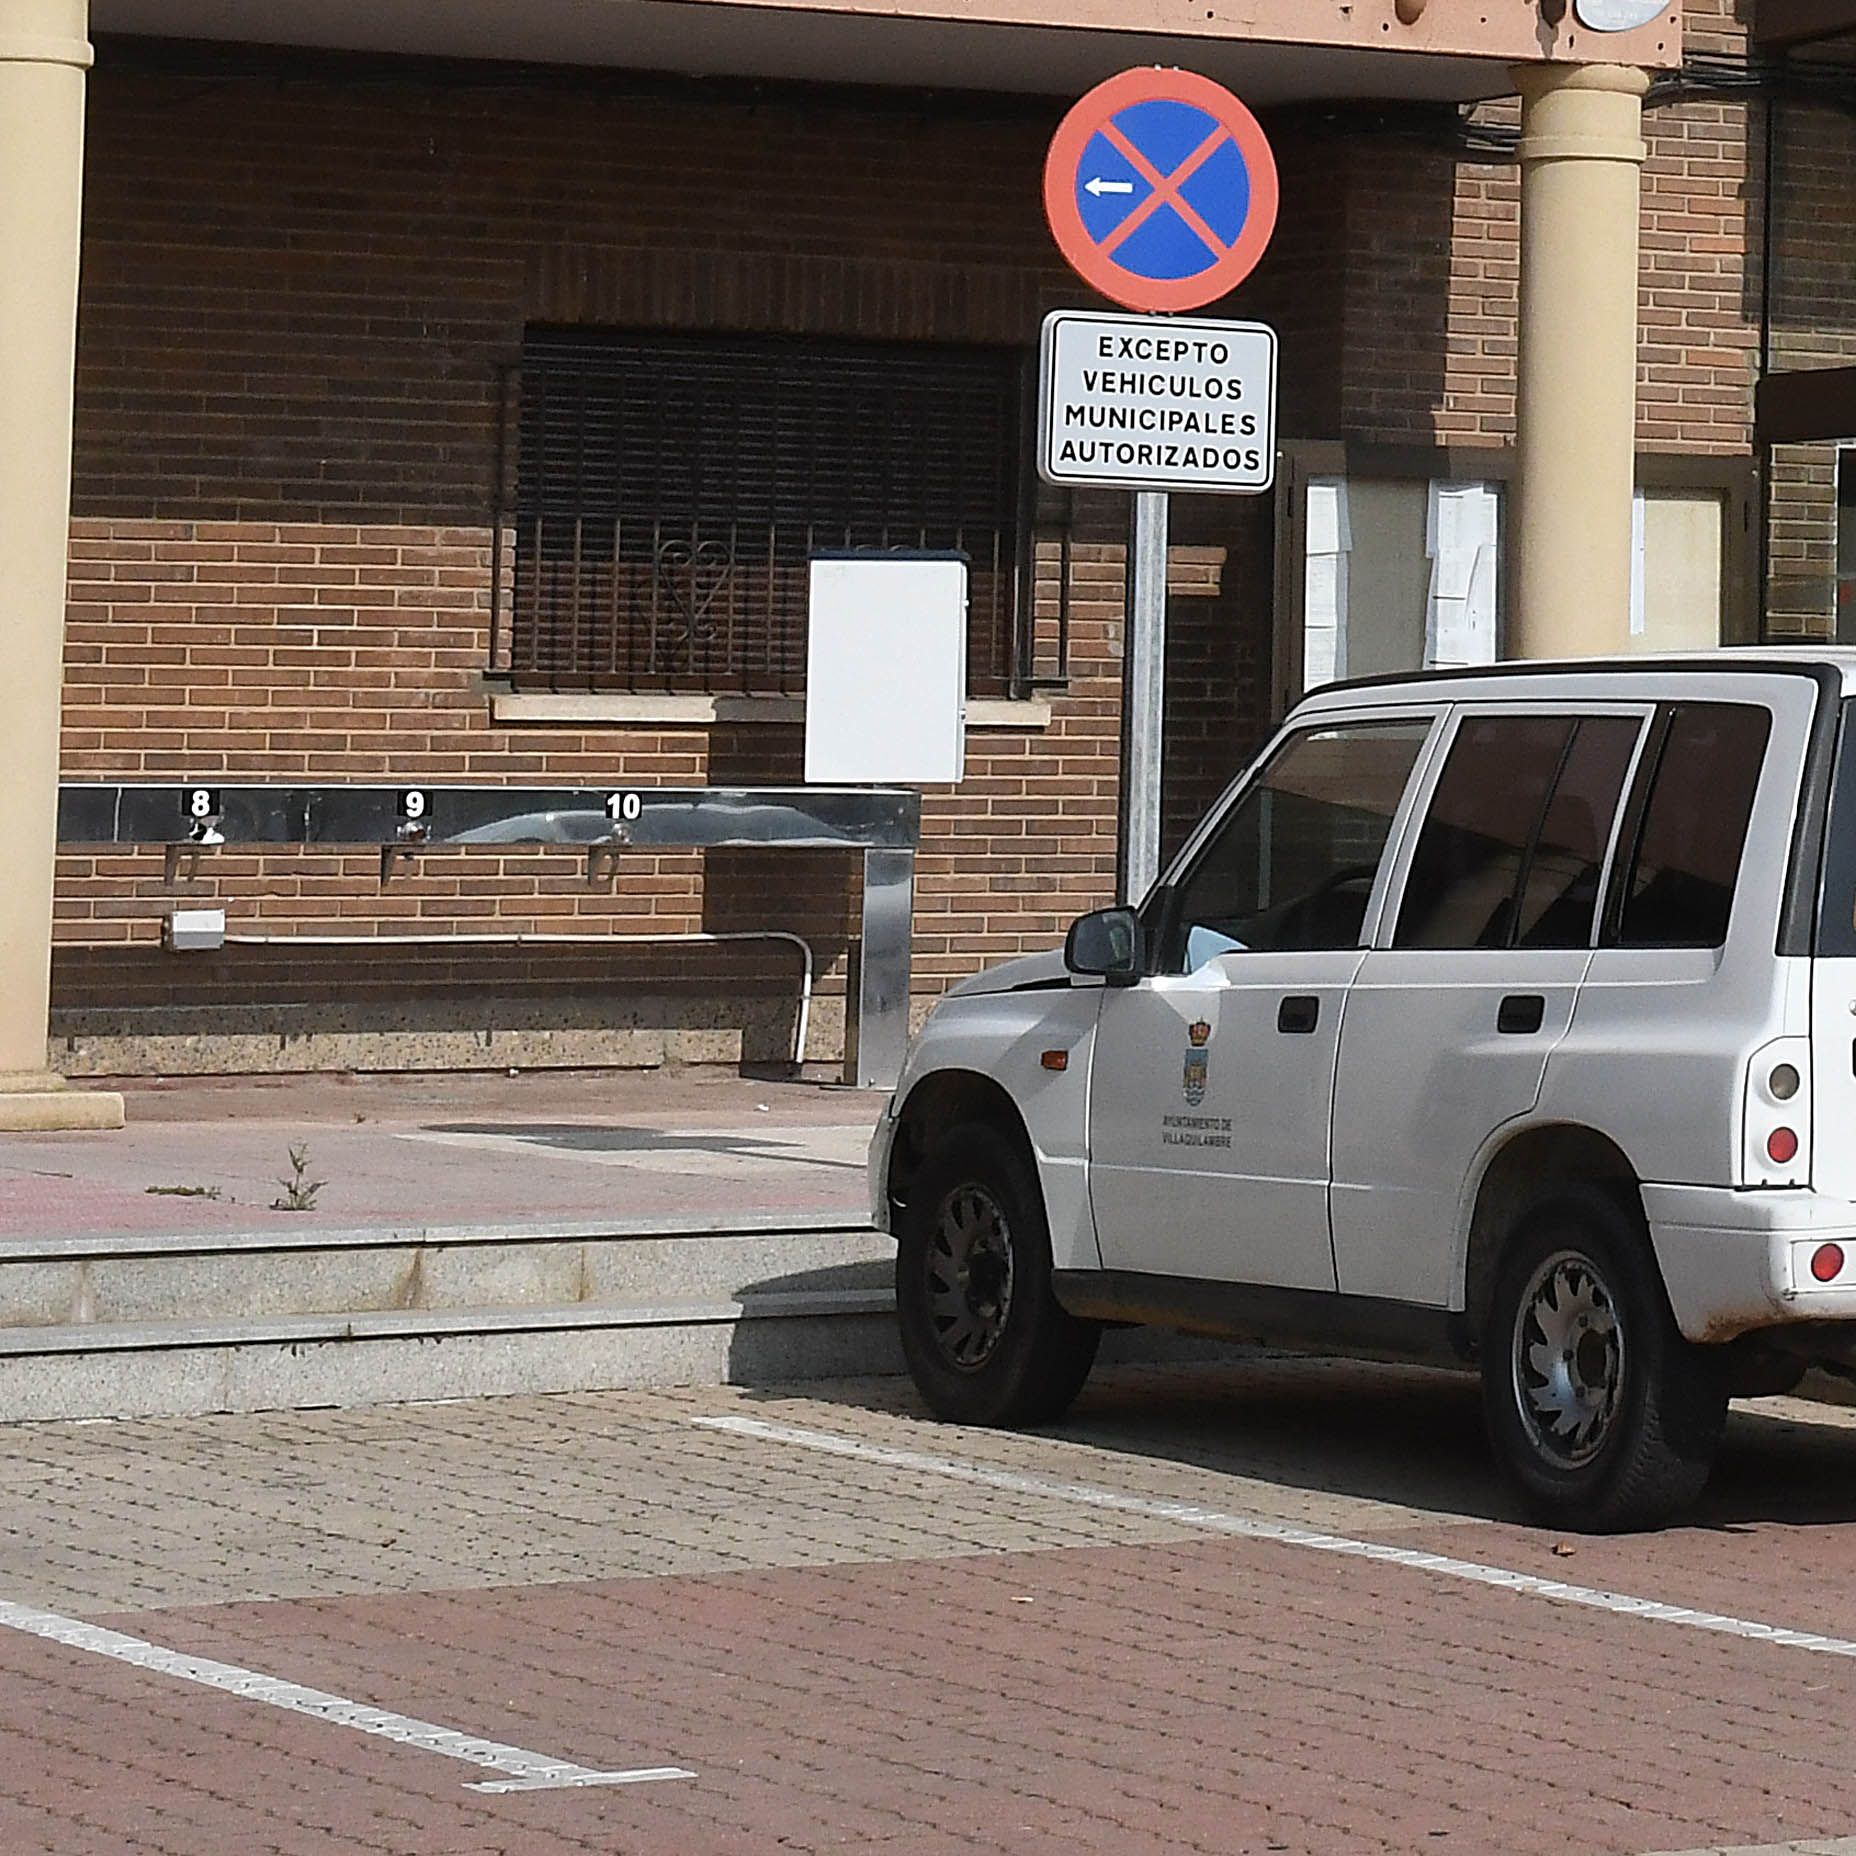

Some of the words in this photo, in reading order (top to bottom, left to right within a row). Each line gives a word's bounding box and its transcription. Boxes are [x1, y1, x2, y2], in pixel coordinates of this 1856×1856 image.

[1099, 335, 1229, 365] EXCEPTO
[1083, 369, 1243, 400] VEHICULOS
[1065, 404, 1256, 436] MUNICIPALES
[1059, 440, 1260, 471] AUTORIZADOS
[191, 790, 210, 817] 8
[406, 791, 424, 818] 9
[607, 793, 640, 819] 10
[1221, 1118, 1232, 1131] DE
